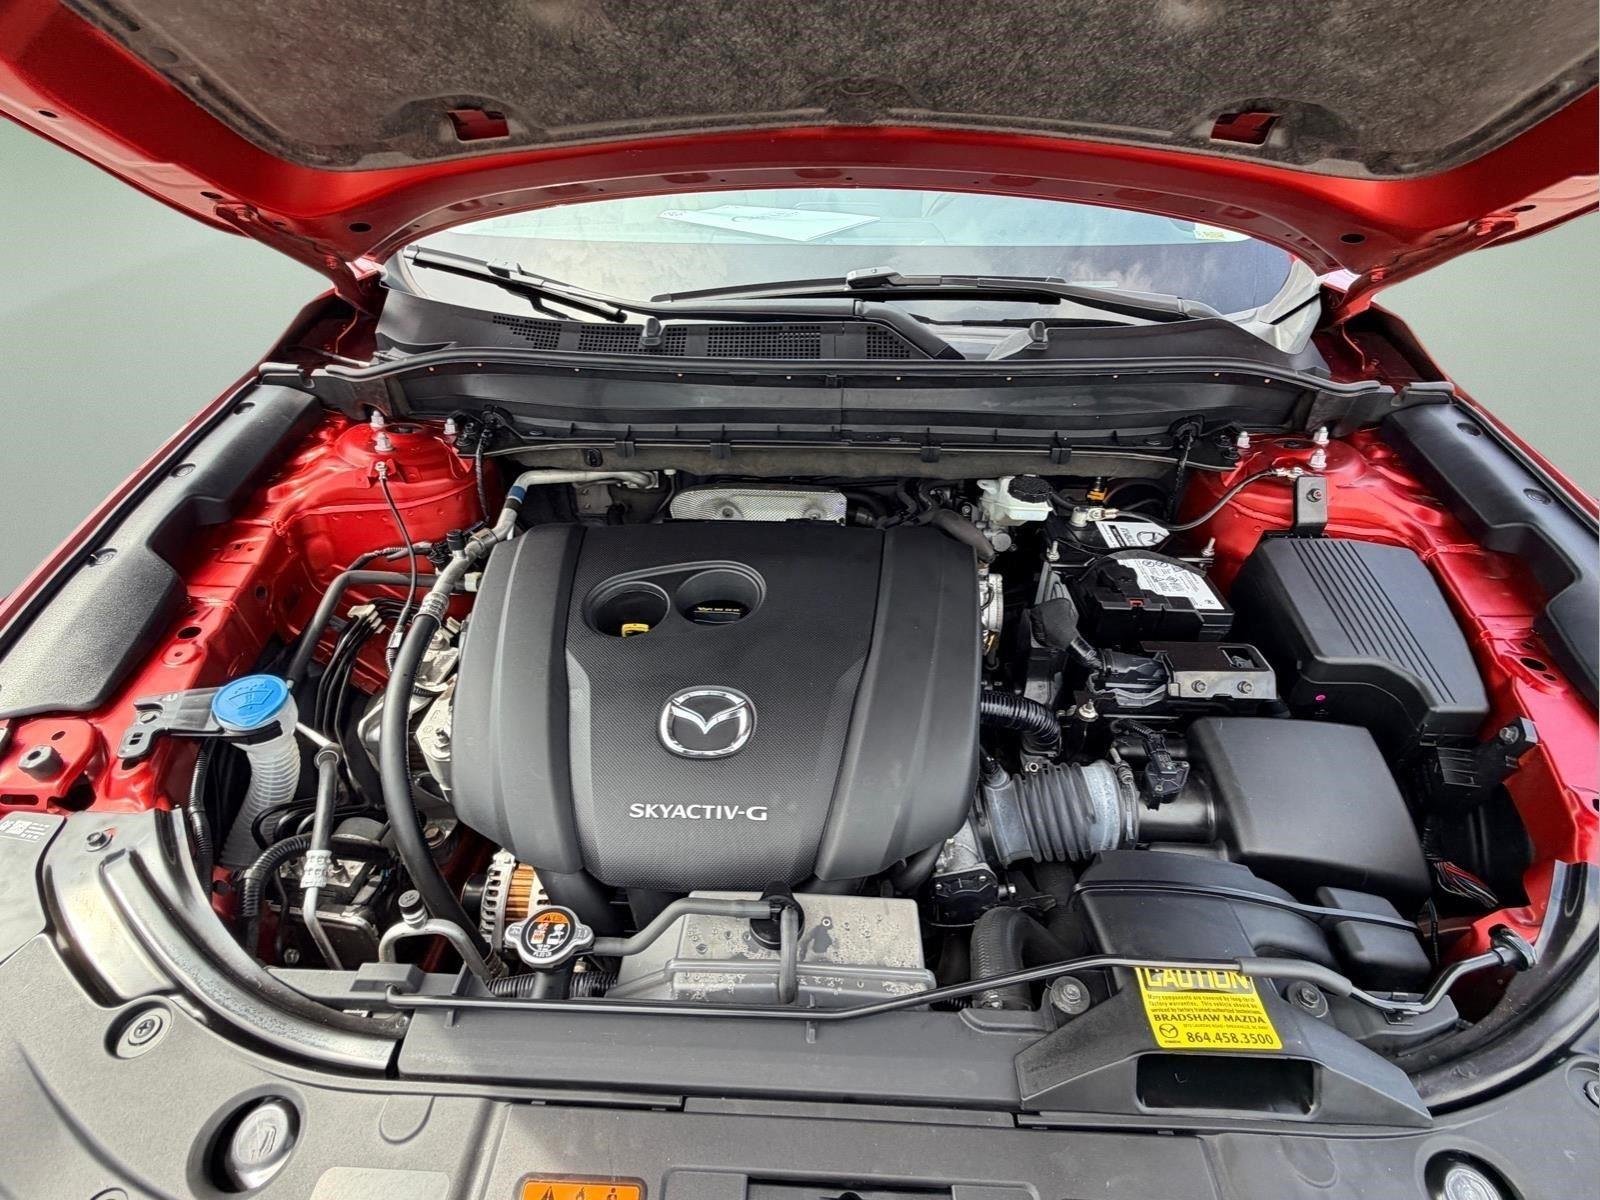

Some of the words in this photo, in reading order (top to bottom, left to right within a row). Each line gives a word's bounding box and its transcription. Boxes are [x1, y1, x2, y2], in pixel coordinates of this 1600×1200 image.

[629, 803, 768, 821] SKYACTIV-G
[1153, 1013, 1220, 1022] BRADSHAW
[1223, 1014, 1267, 1024] MAZDA
[1186, 1031, 1274, 1045] 864.458.3500
